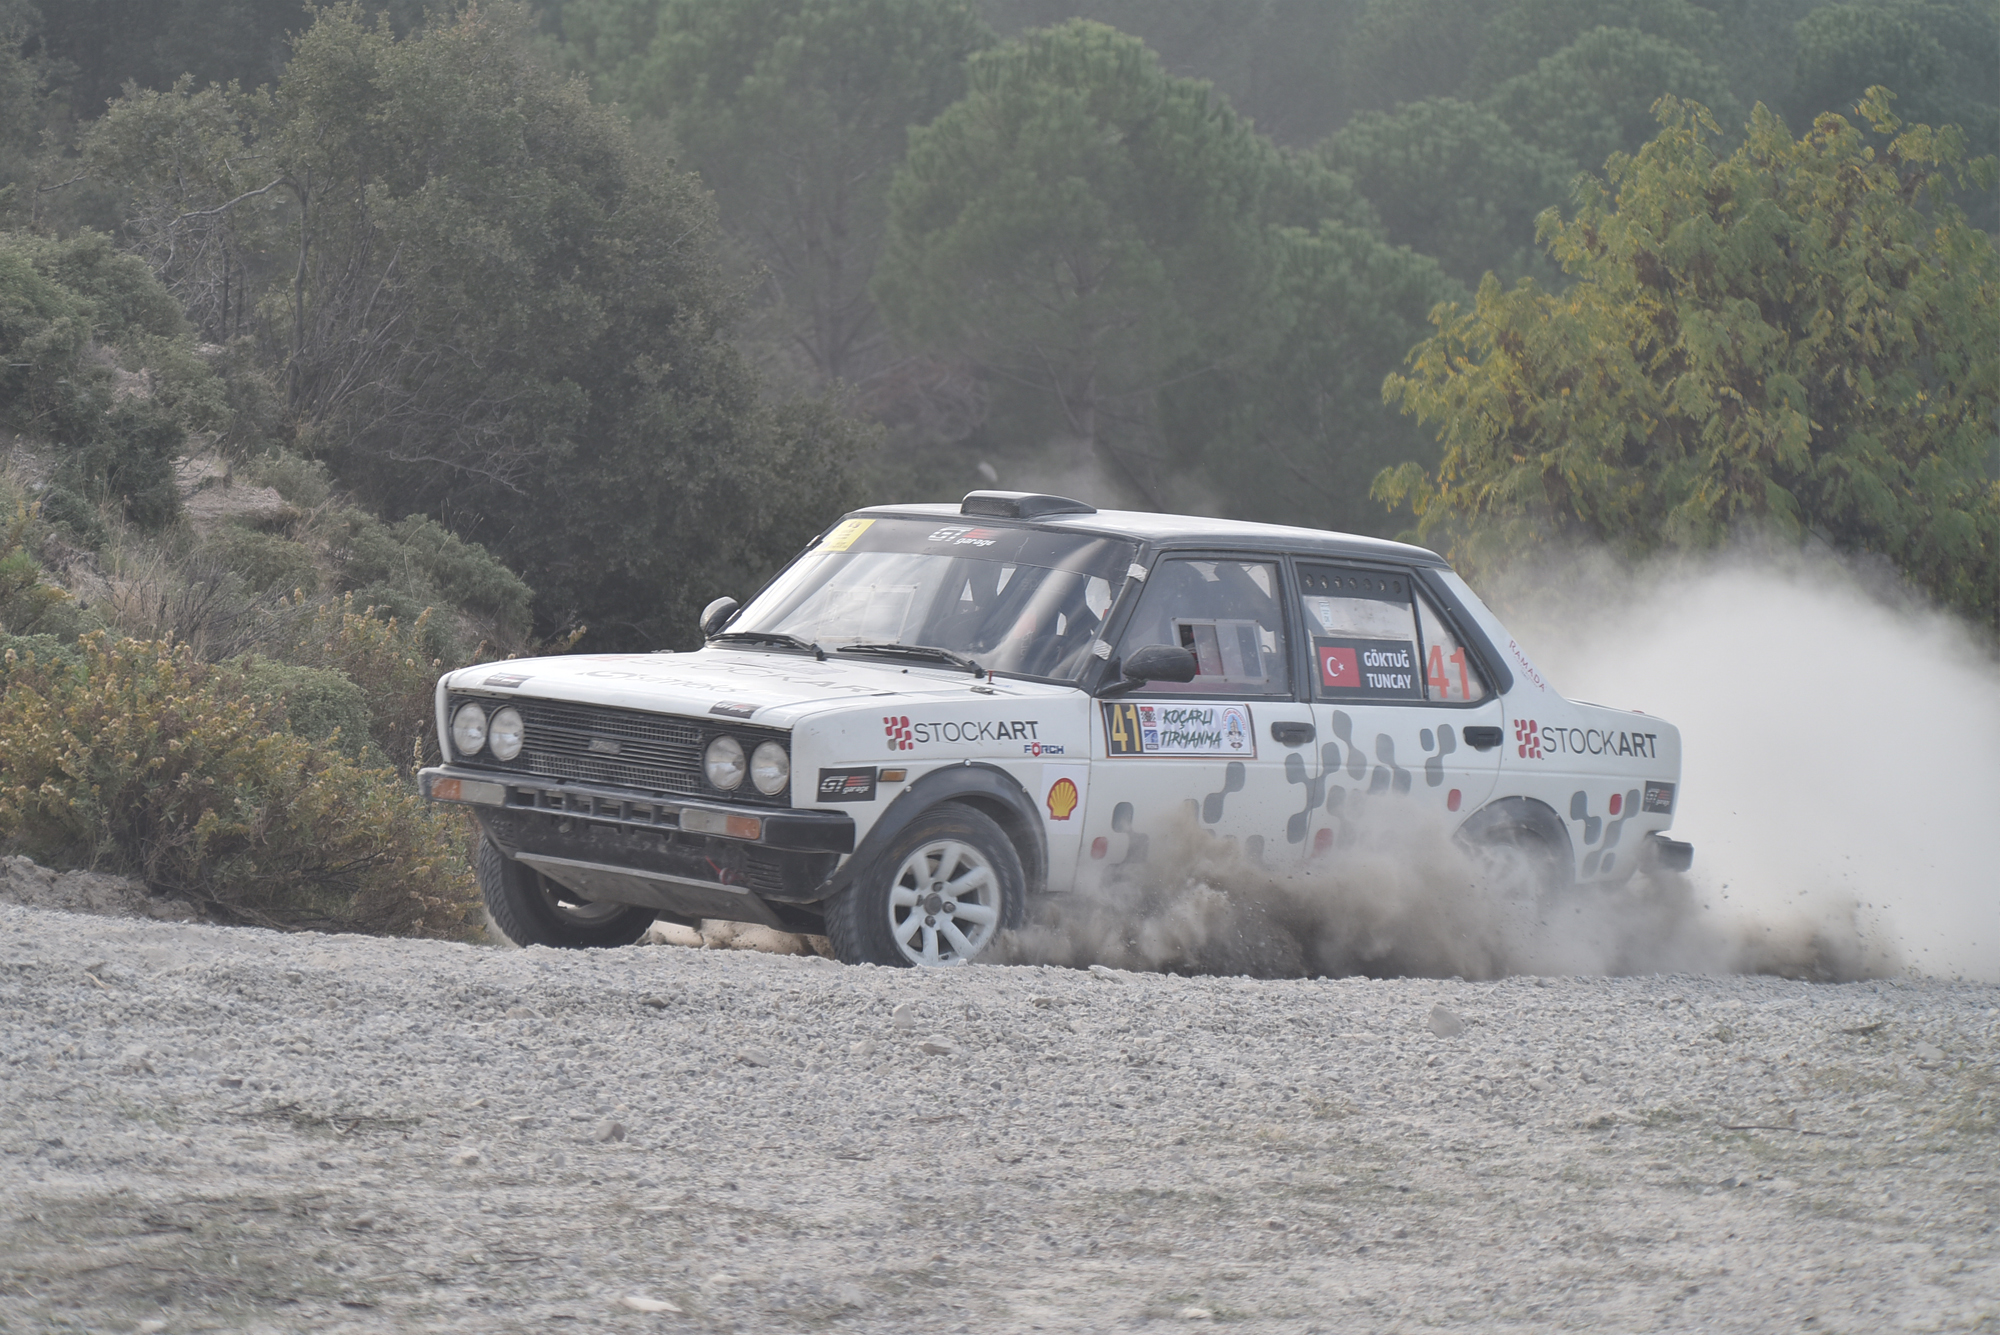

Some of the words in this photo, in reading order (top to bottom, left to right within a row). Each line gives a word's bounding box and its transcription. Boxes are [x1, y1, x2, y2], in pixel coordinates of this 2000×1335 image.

[1363, 649, 1411, 668] GÖKTUĞ
[1509, 640, 1545, 693] RAMADA
[1366, 673, 1412, 689] TUNCAY
[1427, 645, 1471, 700] 41
[1112, 704, 1142, 752] 41
[1163, 708, 1214, 730] KOÇARLI
[914, 720, 1039, 744] STOCKART
[1541, 726, 1657, 759] STOCKART
[820, 775, 848, 793] GT
[842, 785, 870, 795] garage
